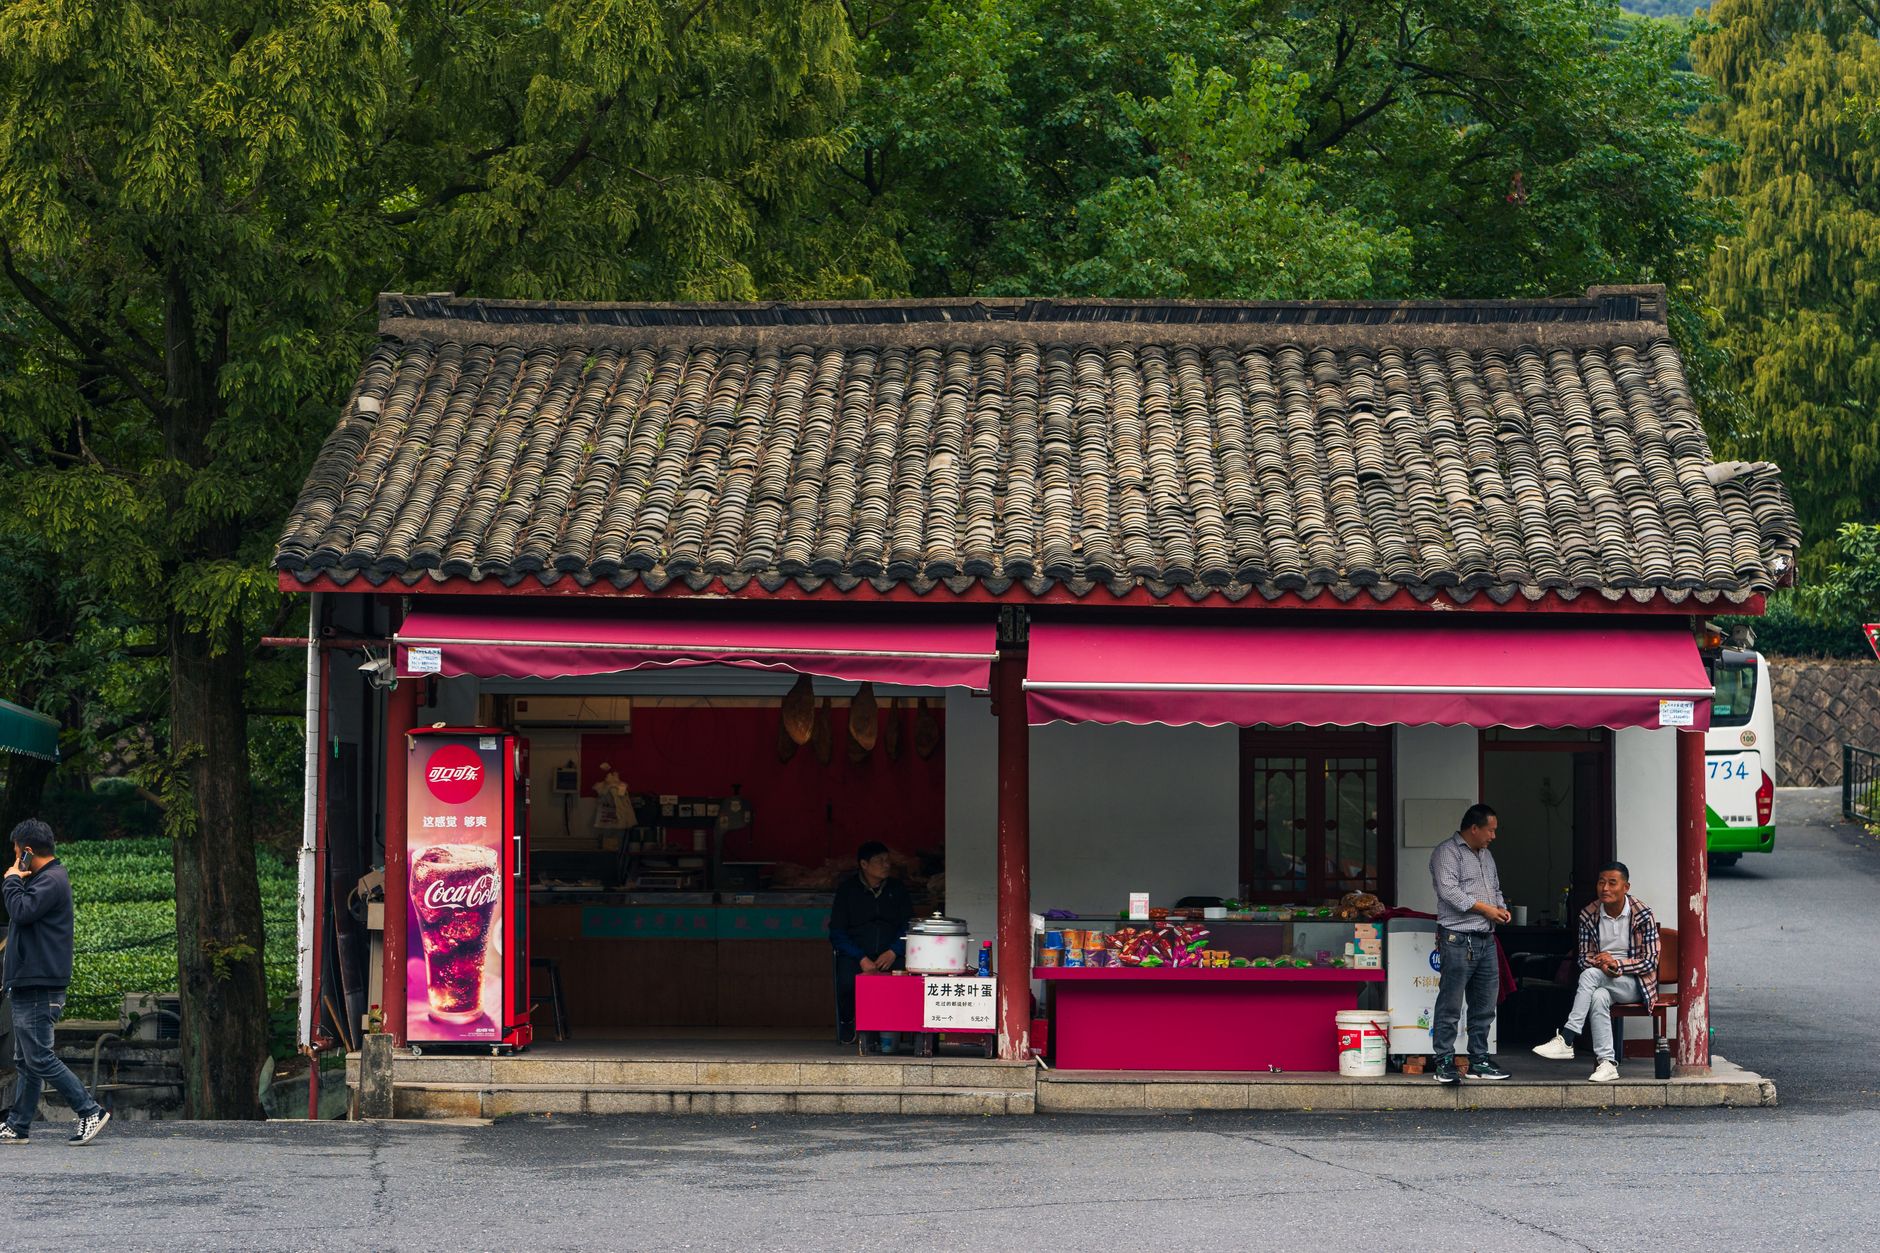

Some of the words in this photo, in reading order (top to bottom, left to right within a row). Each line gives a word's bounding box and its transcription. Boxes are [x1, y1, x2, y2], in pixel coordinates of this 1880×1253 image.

[429, 765, 480, 782] 可口可乐
[1707, 760, 1749, 780] 734
[423, 816, 457, 827] 这感觉
[464, 816, 487, 827] 够爽
[927, 983, 993, 997] 龙井茶叶蛋
